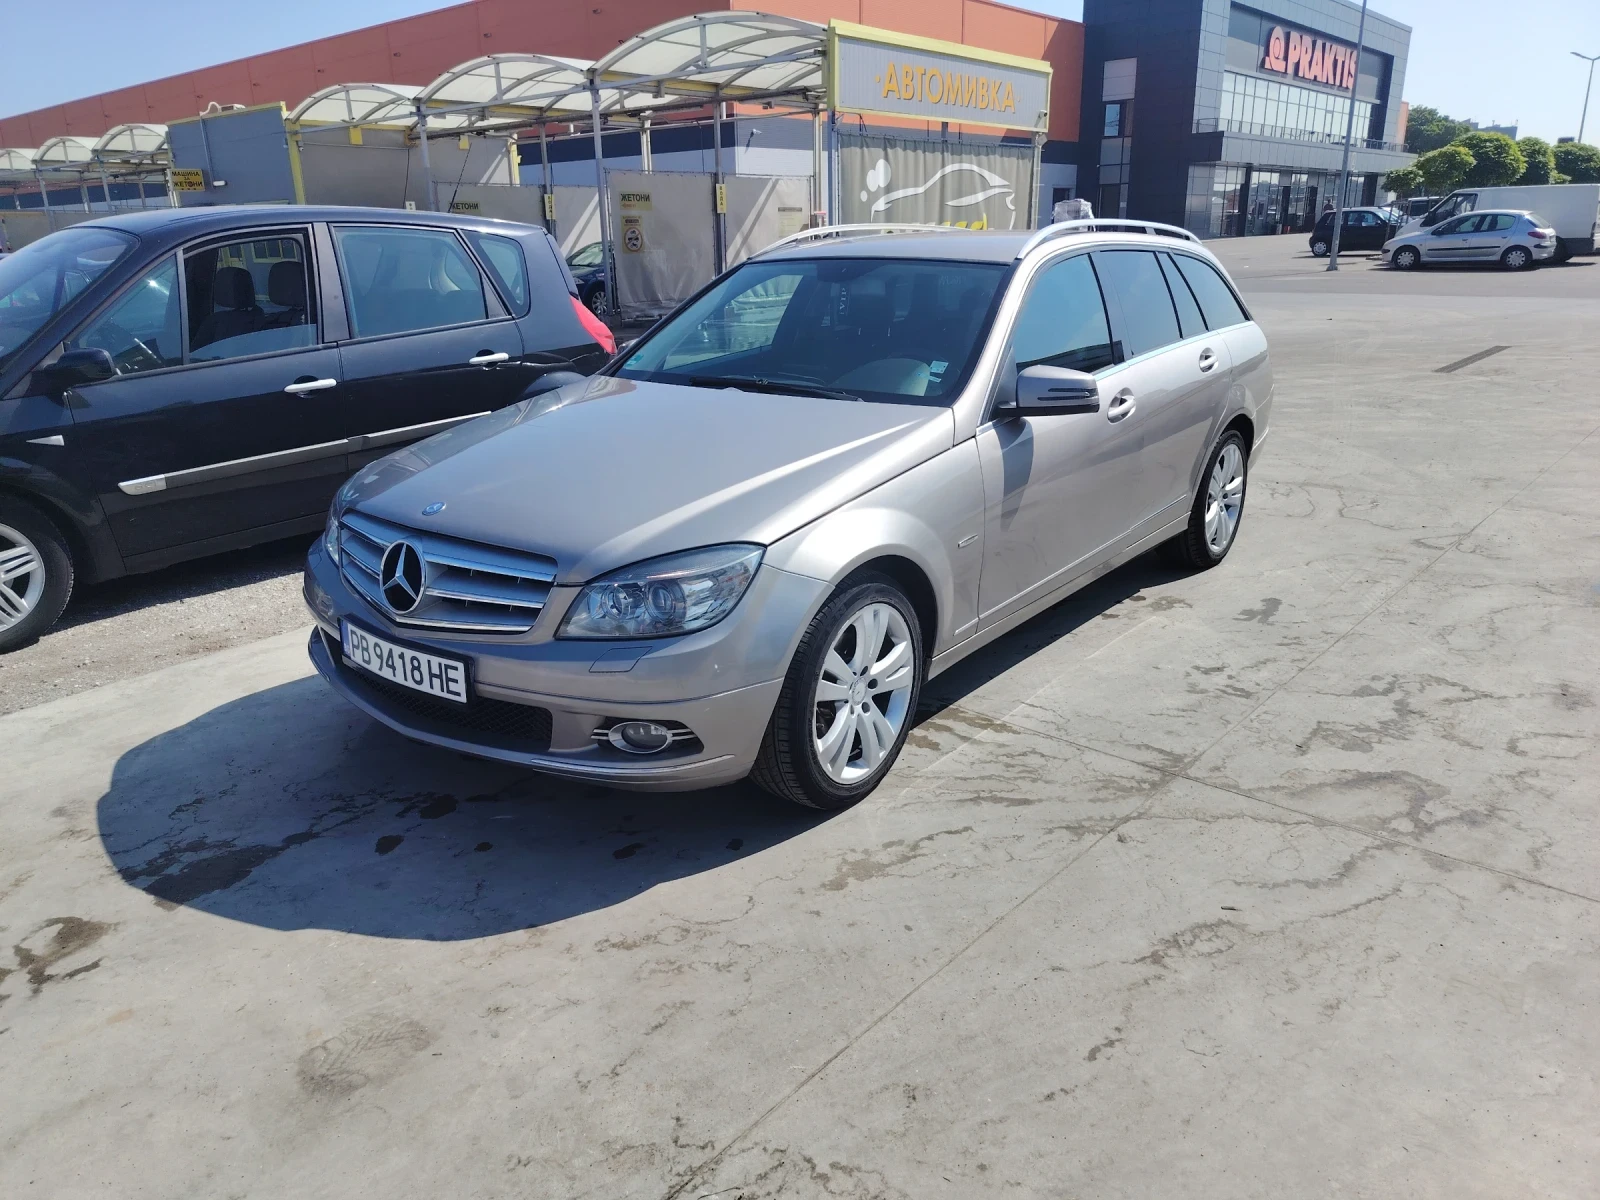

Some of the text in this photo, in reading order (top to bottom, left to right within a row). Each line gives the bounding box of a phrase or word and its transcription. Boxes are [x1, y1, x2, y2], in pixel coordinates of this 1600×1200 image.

[1287, 31, 1358, 89] PRAKTIS
[882, 61, 1016, 113] АВТОМИВКА
[620, 193, 651, 202] ЖЕТОНИ
